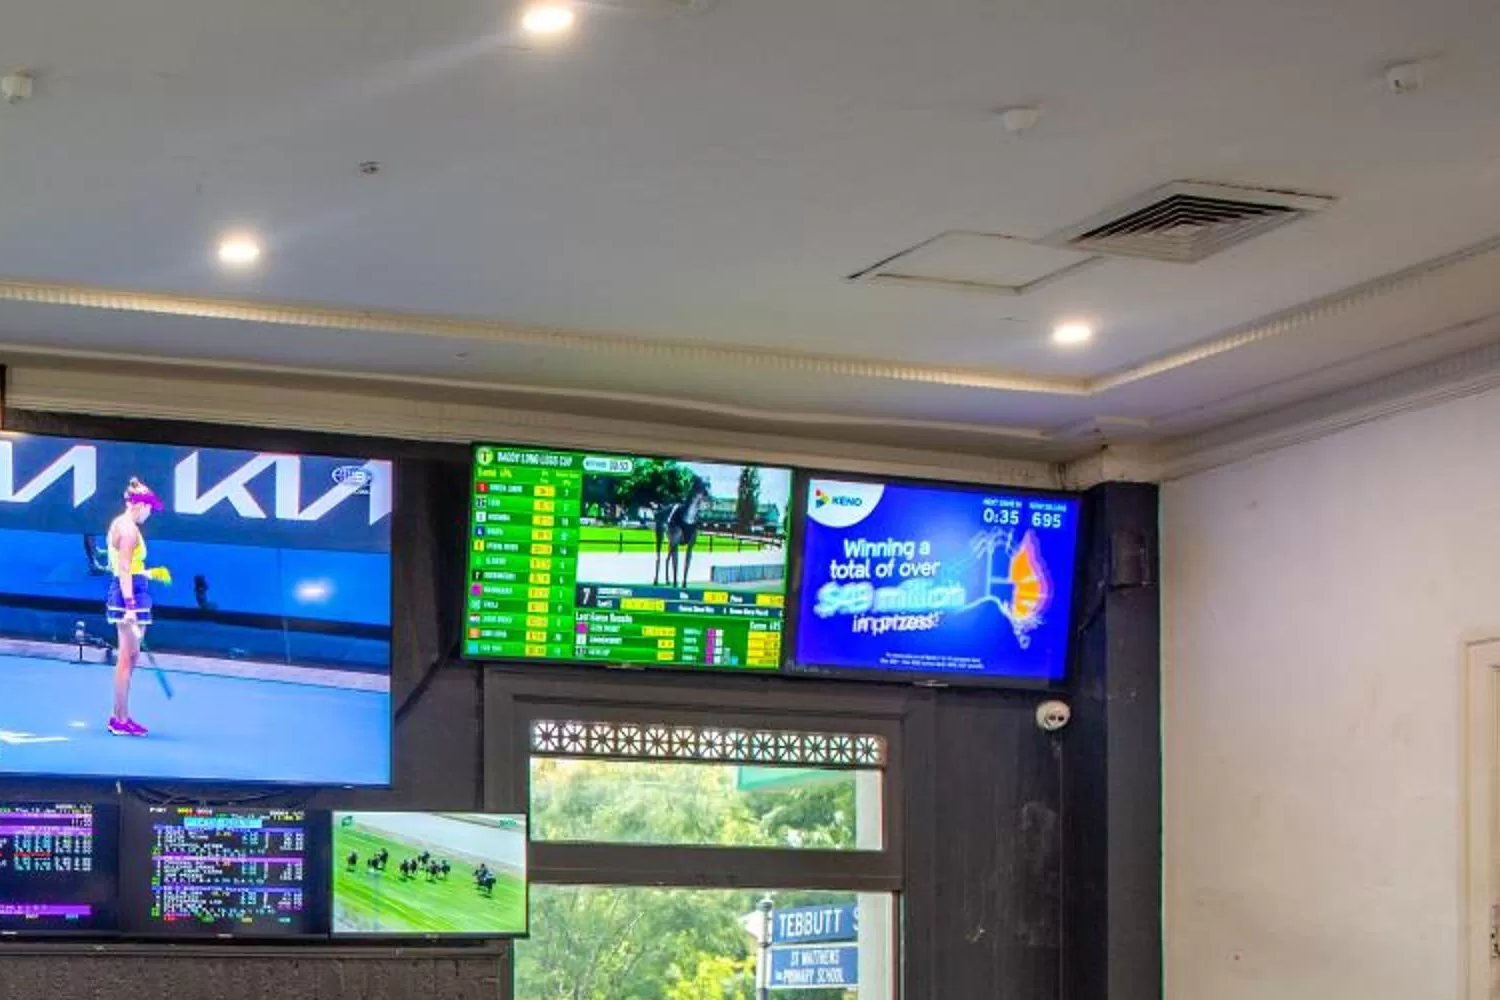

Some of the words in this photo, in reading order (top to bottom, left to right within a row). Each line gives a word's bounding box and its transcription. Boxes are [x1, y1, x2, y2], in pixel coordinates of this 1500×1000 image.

[174, 450, 393, 526] KIA
[832, 495, 863, 508] KENO
[983, 507, 1020, 525] 0:35
[1032, 512, 1061, 528] 695
[843, 538, 915, 559] Winning
[918, 543, 931, 557] a
[830, 560, 870, 579] total
[875, 559, 896, 578] of
[899, 562, 941, 578] over
[779, 908, 844, 937] TEBBUTT
[784, 968, 814, 985] PRIMARY
[817, 967, 845, 983] SCHOOL
